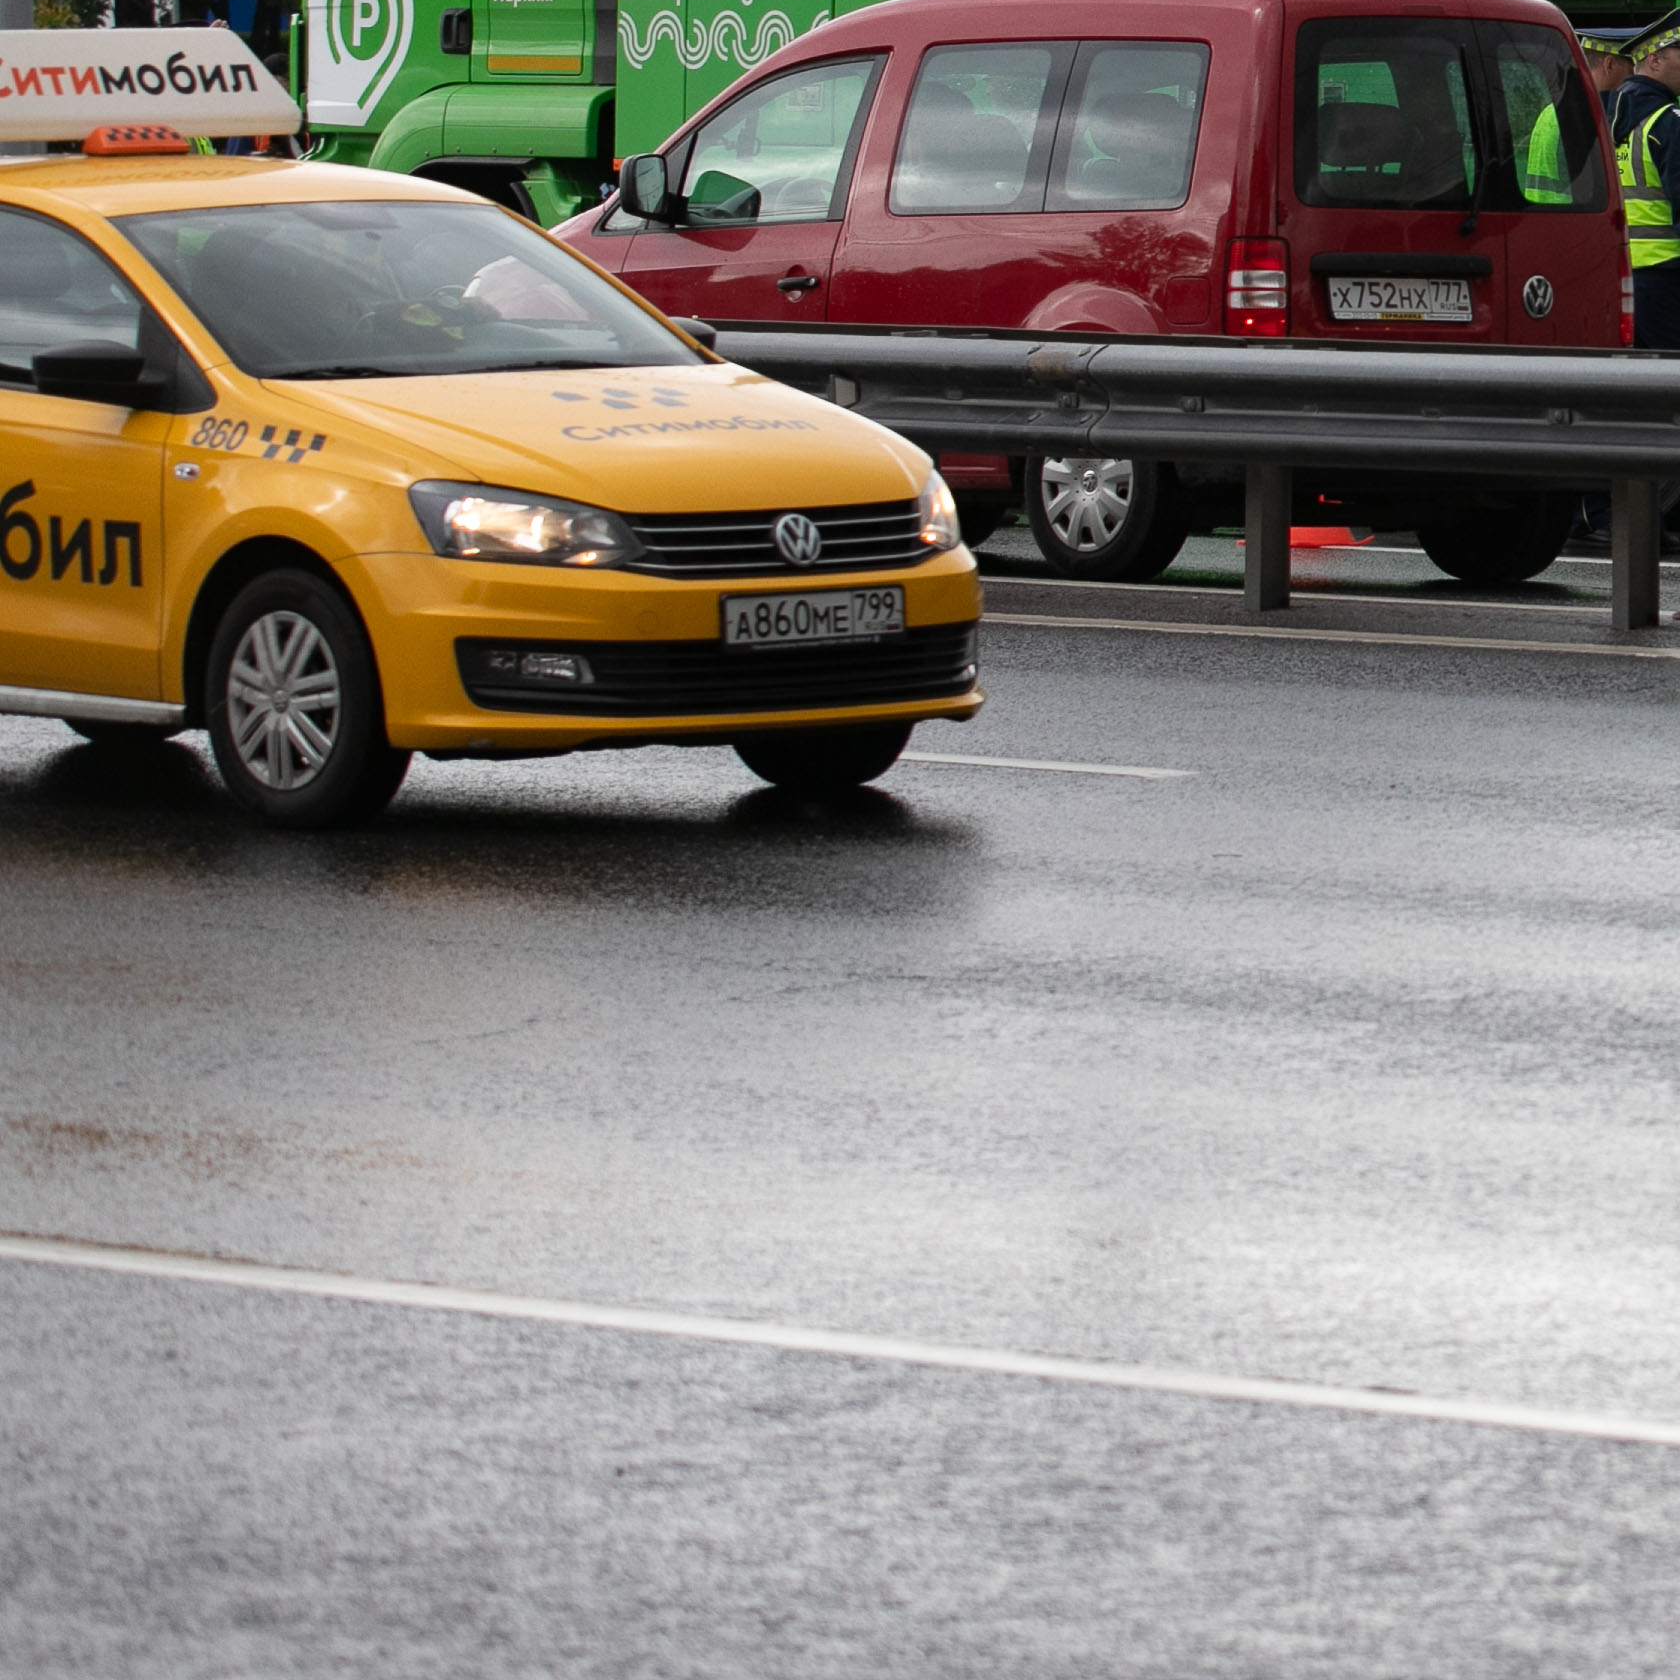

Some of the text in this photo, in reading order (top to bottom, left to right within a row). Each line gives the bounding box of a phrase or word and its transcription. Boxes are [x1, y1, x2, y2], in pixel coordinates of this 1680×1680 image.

[190, 416, 250, 452] 860
[560, 415, 820, 442] Ситимобил
[853, 591, 896, 621] 799
